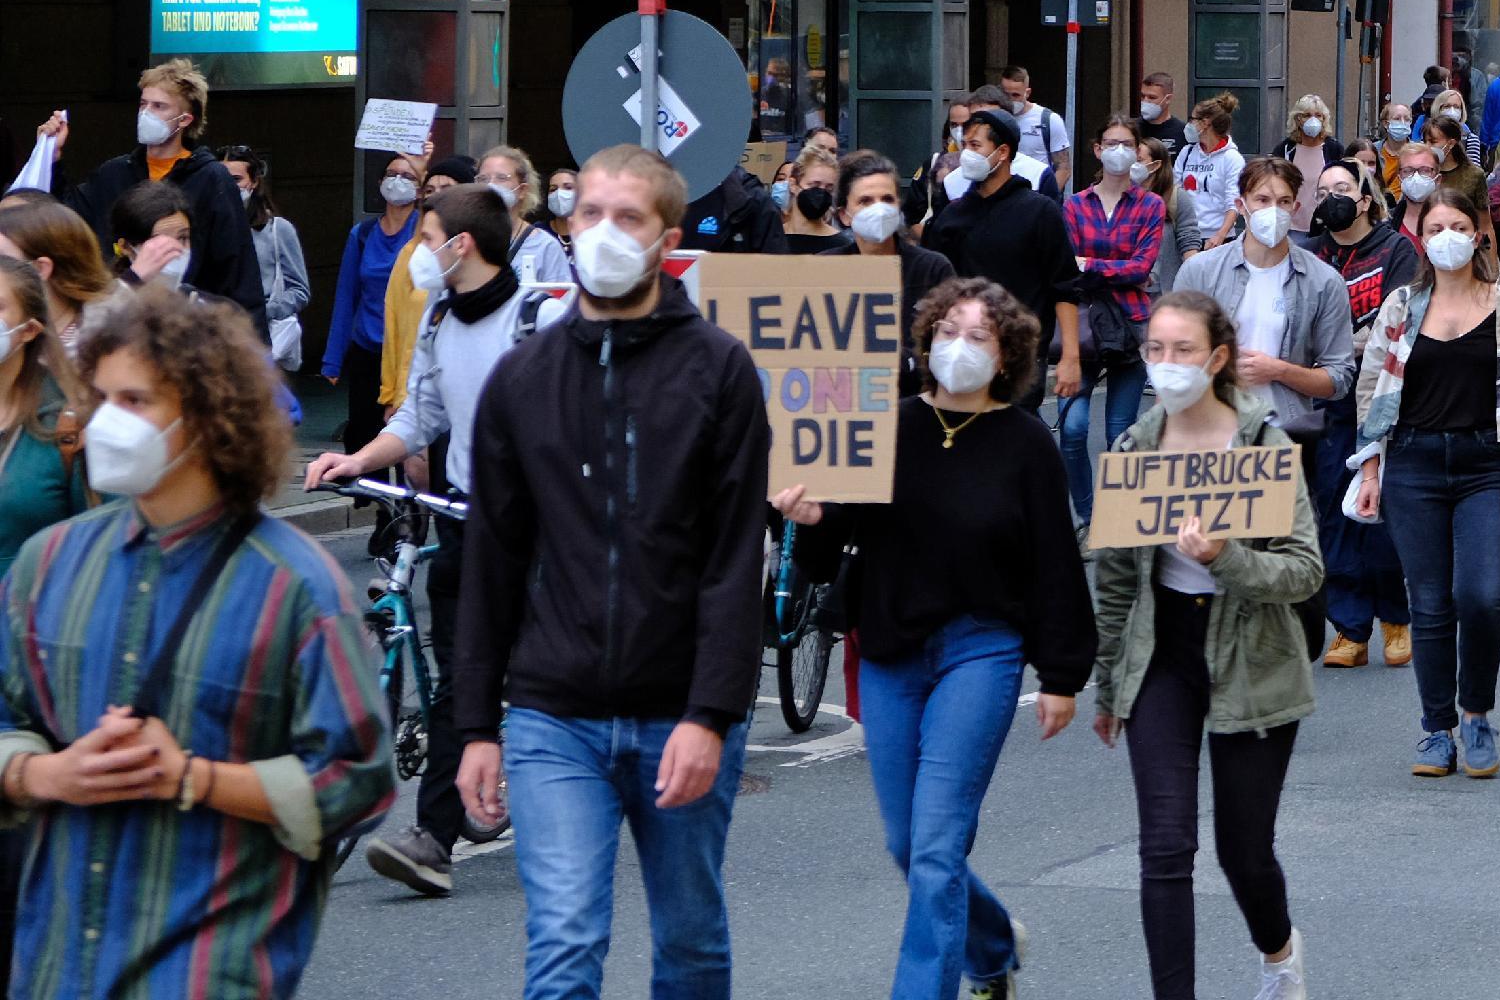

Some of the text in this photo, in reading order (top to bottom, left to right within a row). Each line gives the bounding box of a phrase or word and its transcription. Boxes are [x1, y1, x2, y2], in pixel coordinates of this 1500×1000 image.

[162, 11, 191, 32] TABLET
[193, 11, 211, 32] UND
[792, 417, 874, 467] DIE
[1101, 448, 1293, 490] LUFTBRÜCKE
[1136, 489, 1264, 536] JETZT
